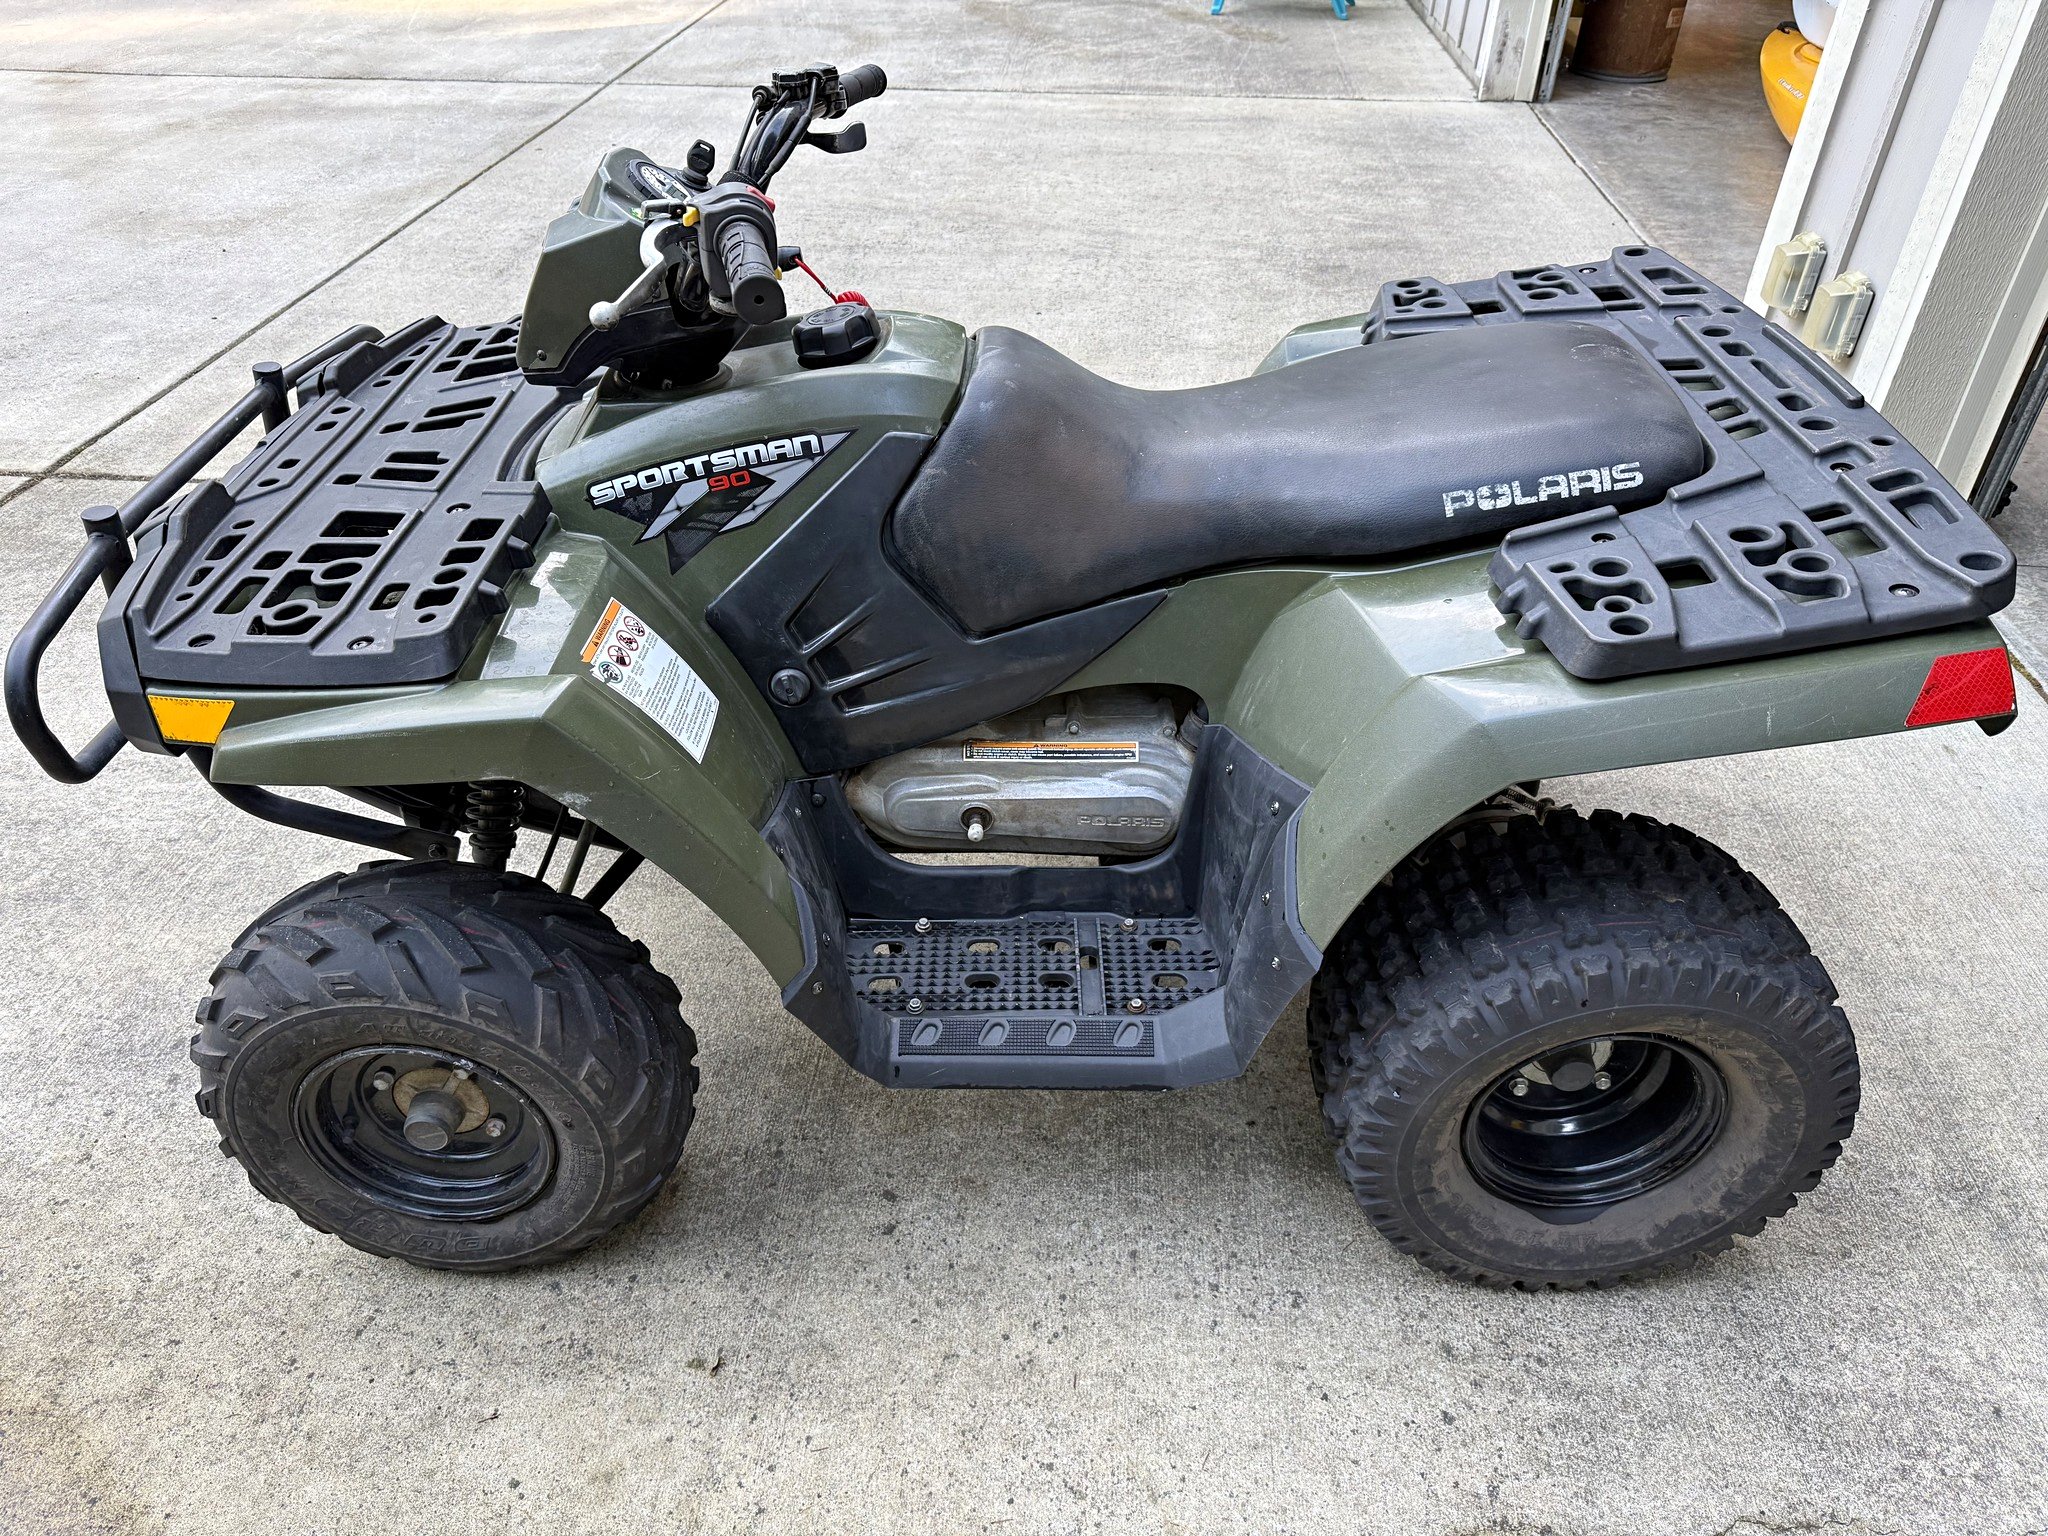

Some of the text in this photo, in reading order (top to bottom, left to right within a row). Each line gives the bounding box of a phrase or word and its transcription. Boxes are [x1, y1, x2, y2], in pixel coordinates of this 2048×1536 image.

[589, 434, 821, 506] SPORTSMAN
[707, 470, 751, 493] 90
[1441, 461, 1644, 518] POLARIS
[595, 618, 611, 642] WARNING
[1076, 815, 1165, 828] POLARIS
